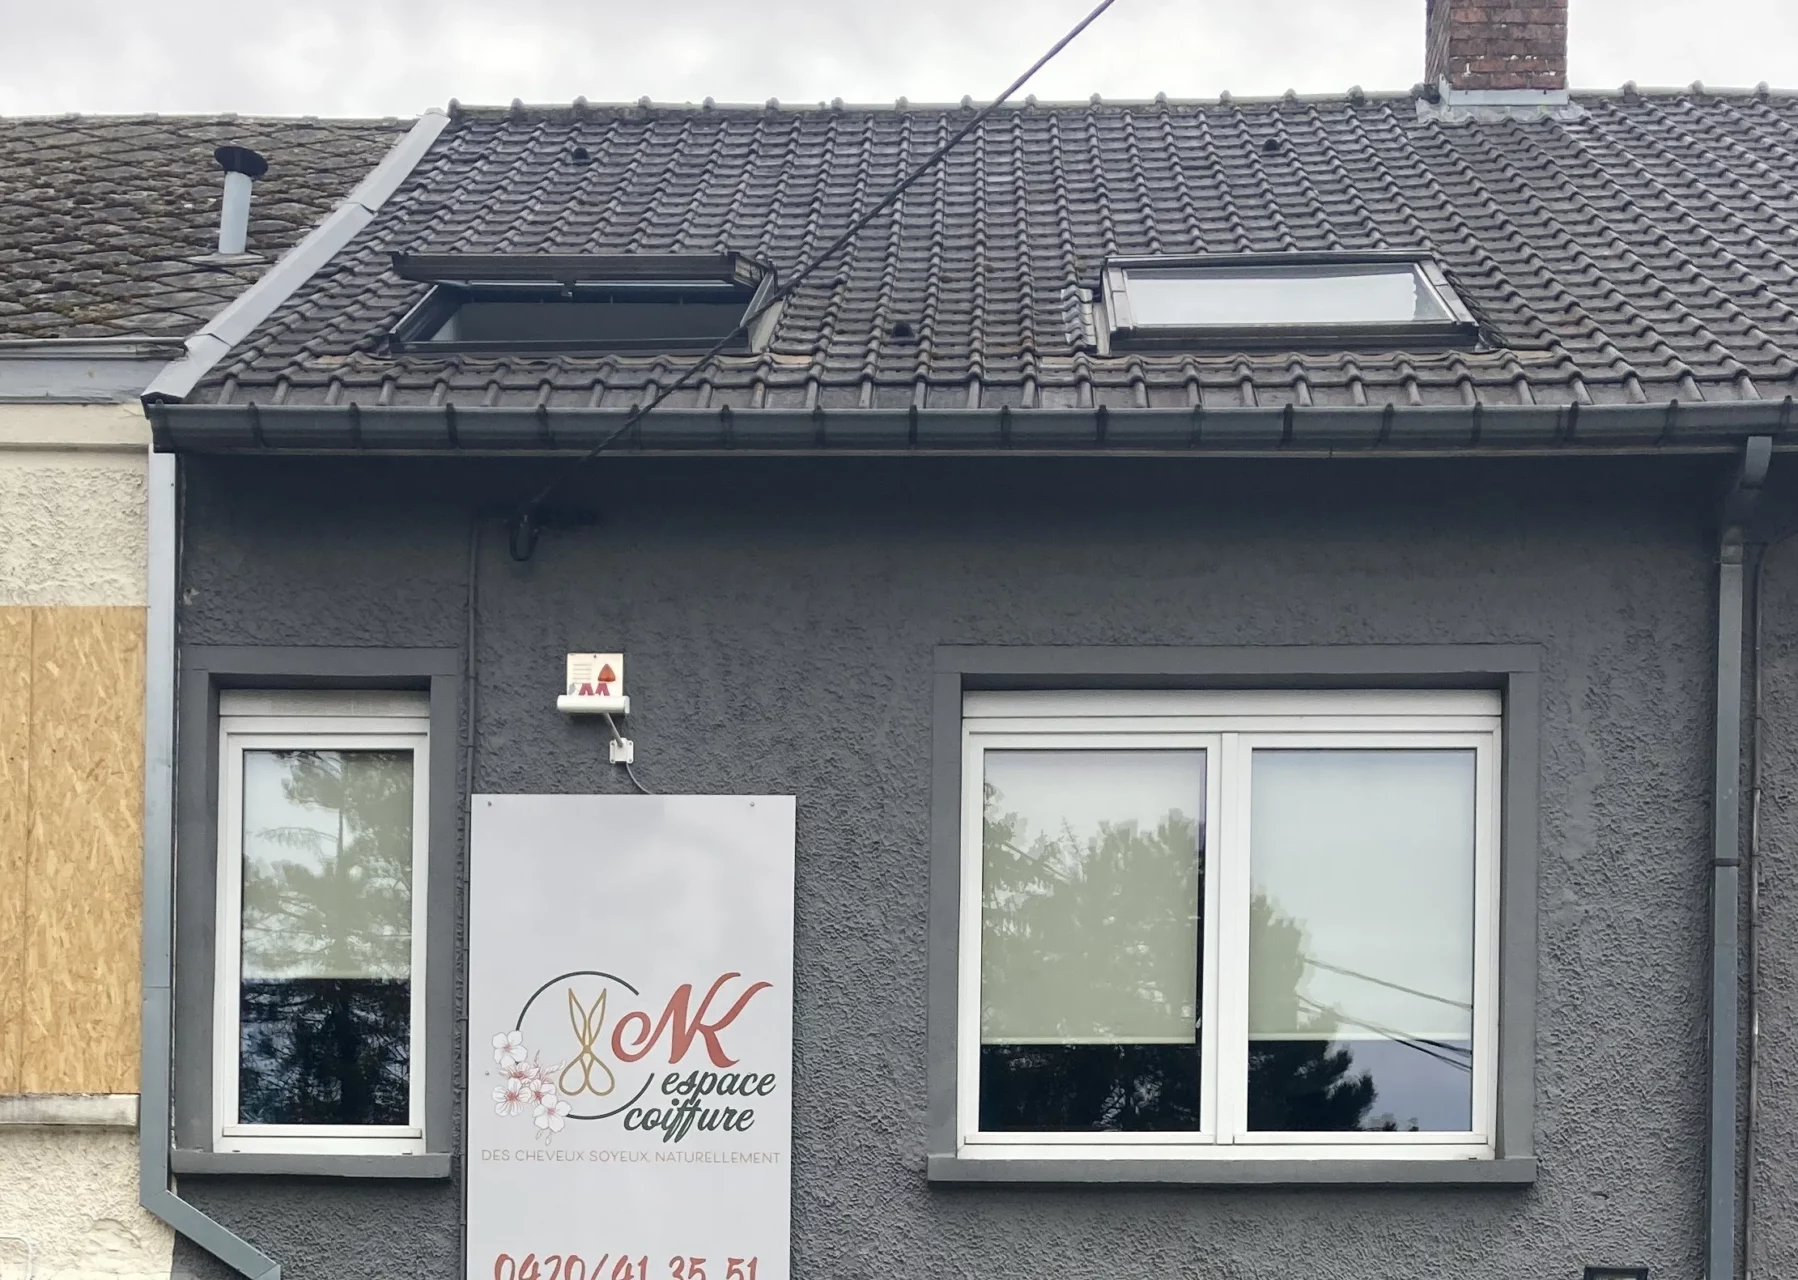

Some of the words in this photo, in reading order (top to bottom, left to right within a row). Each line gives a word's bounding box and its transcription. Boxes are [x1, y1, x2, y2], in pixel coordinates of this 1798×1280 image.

[611, 972, 774, 1068] NK
[661, 1070, 777, 1105] espace
[623, 1098, 755, 1143] coiffure
[481, 1149, 510, 1161] DES
[515, 1149, 585, 1162] CHEVEUX
[655, 1151, 781, 1164] NATURELLEMENT
